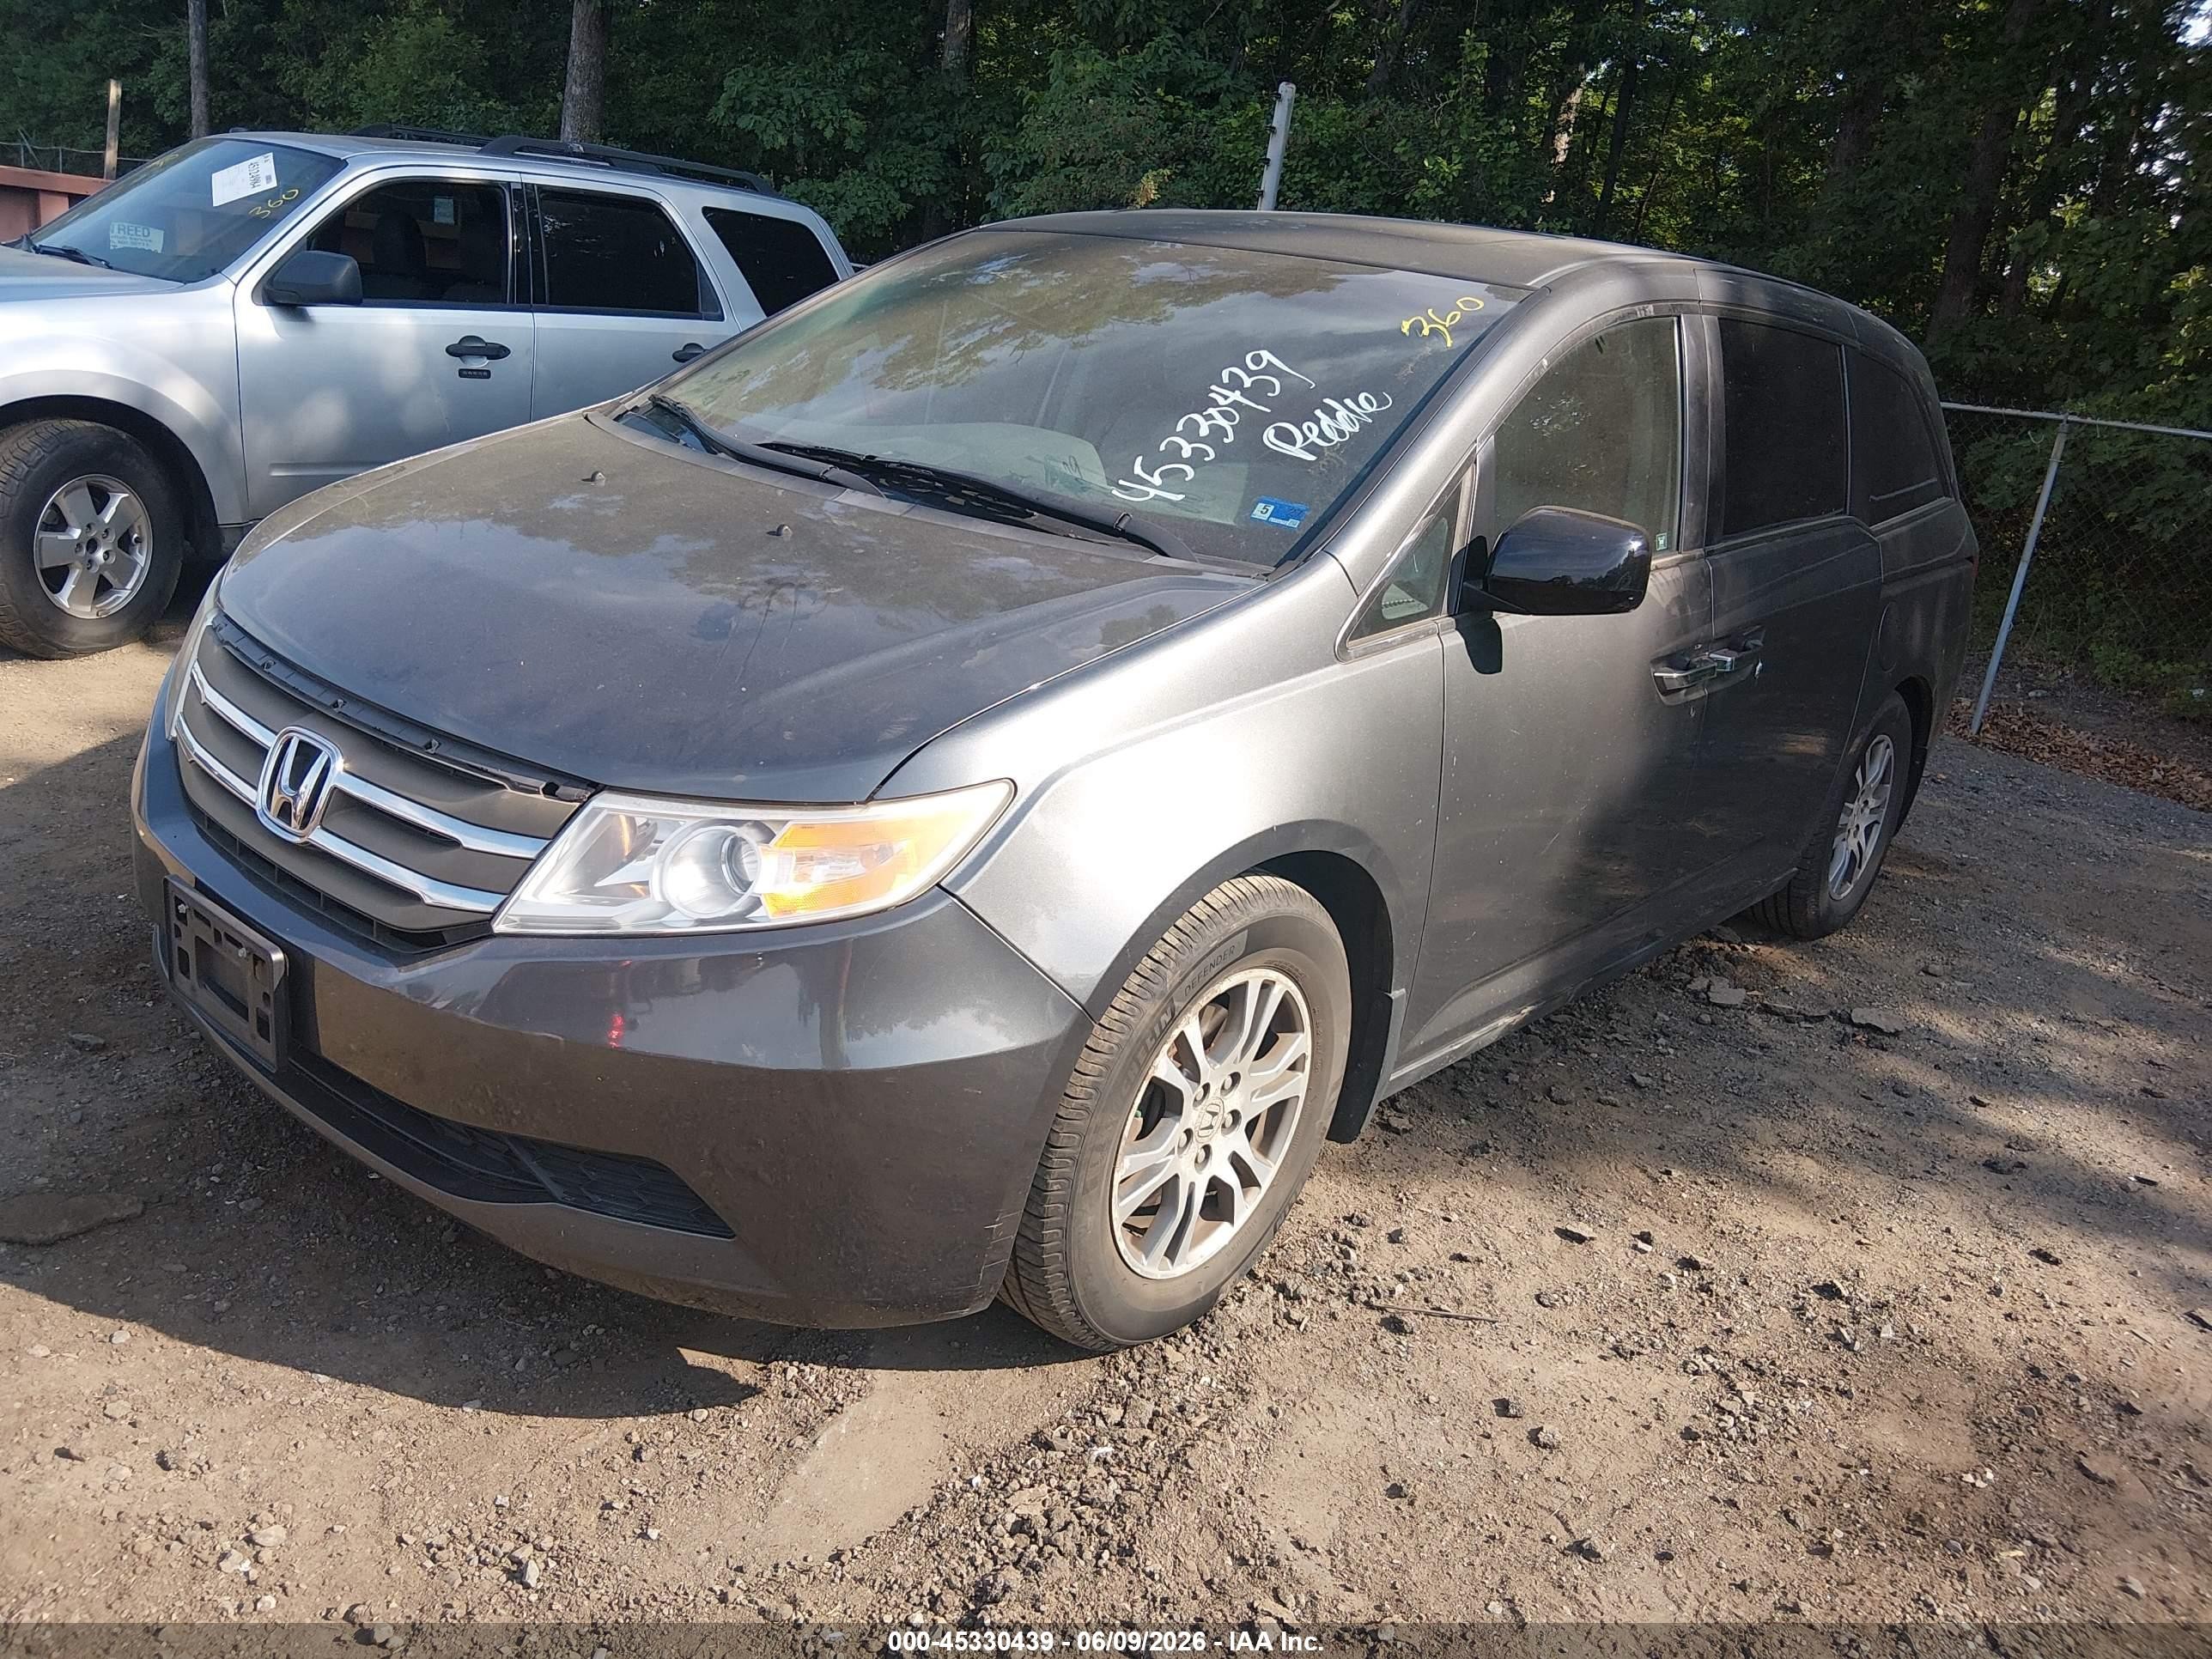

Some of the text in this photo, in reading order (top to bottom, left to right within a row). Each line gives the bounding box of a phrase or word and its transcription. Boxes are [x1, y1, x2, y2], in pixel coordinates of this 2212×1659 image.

[118, 223, 151, 237] REED
[248, 189, 299, 219] 360
[1401, 296, 1485, 348] 360
[1184, 945, 1235, 997] DEFENDER
[1111, 1004, 1175, 1103] CHELIN
